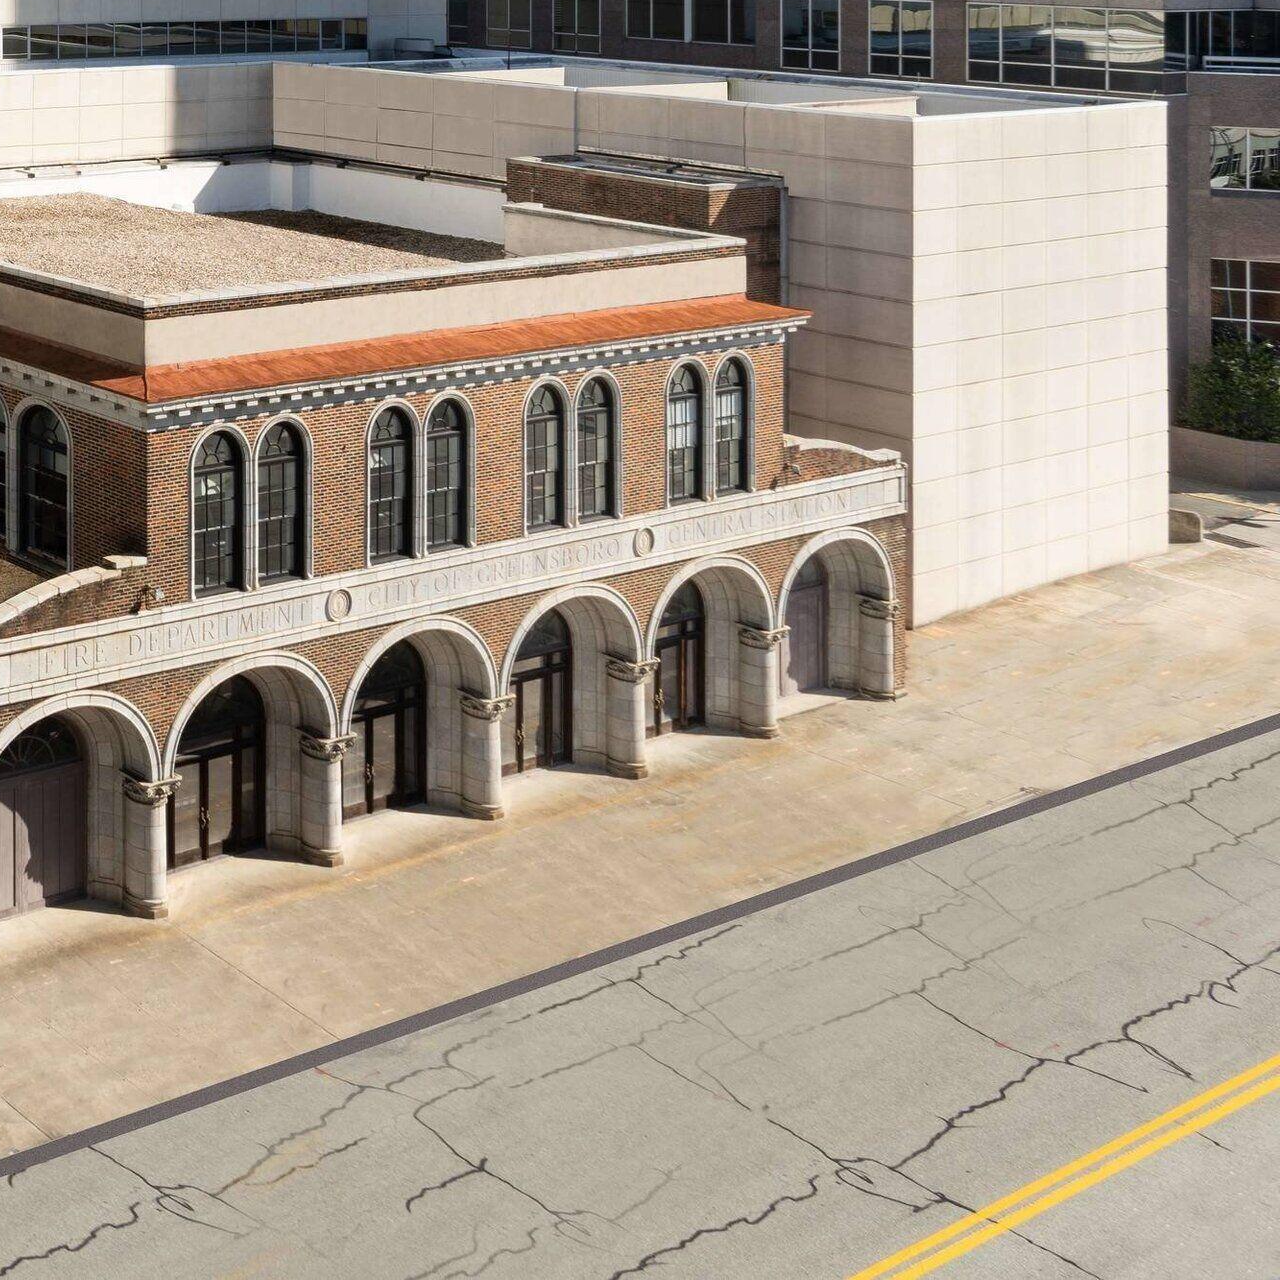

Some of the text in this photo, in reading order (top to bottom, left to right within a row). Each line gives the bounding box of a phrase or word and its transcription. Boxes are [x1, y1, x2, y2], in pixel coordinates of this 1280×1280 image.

[44, 491, 852, 675] FIRE DEPARTMENT CITY OF GREENSBORO CENTRAL STATION
